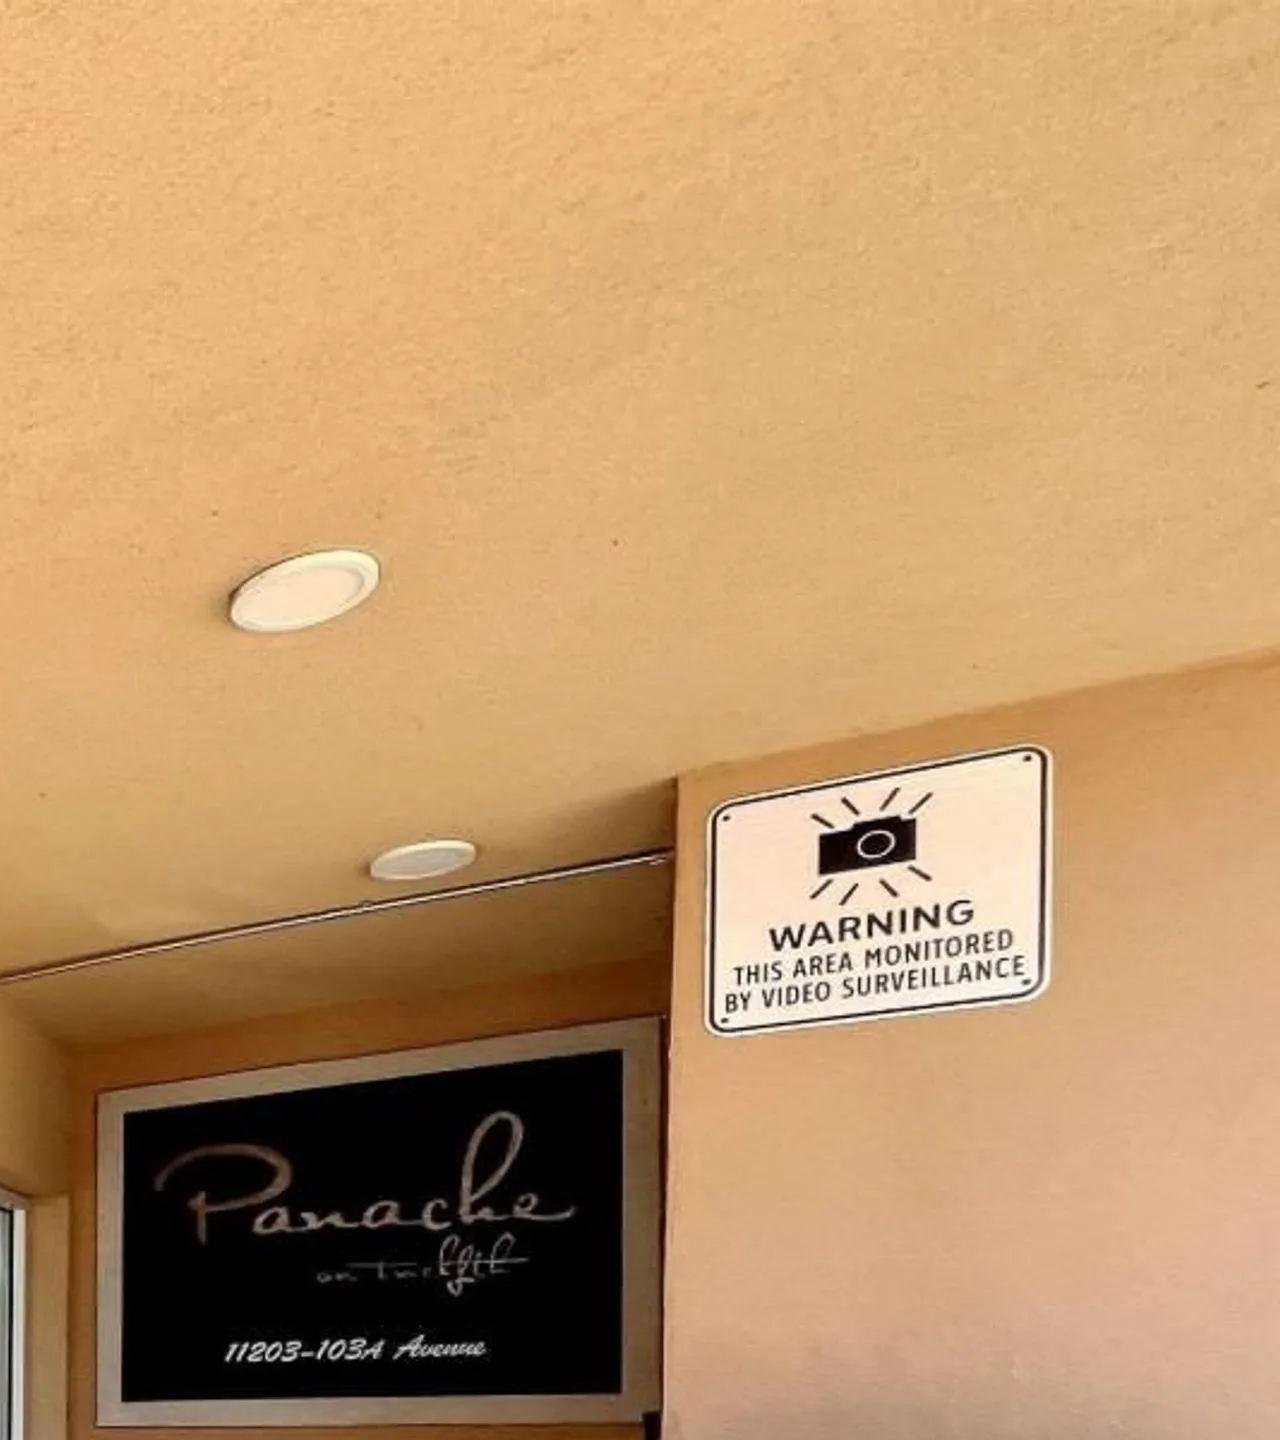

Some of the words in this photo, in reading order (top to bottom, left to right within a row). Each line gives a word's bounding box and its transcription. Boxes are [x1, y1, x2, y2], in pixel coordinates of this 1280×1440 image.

[769, 900, 974, 951] WARNING
[725, 992, 751, 1014] BY
[761, 981, 831, 1009] VIDEO
[842, 955, 1026, 998] SURVEILLANCE
[733, 960, 782, 986] THIS
[793, 951, 853, 978] AREA
[865, 929, 1013, 968] MONITORED
[154, 1110, 575, 1244] Panache
[225, 1338, 386, 1363] 11203-103A
[392, 1334, 487, 1361] Avenue
